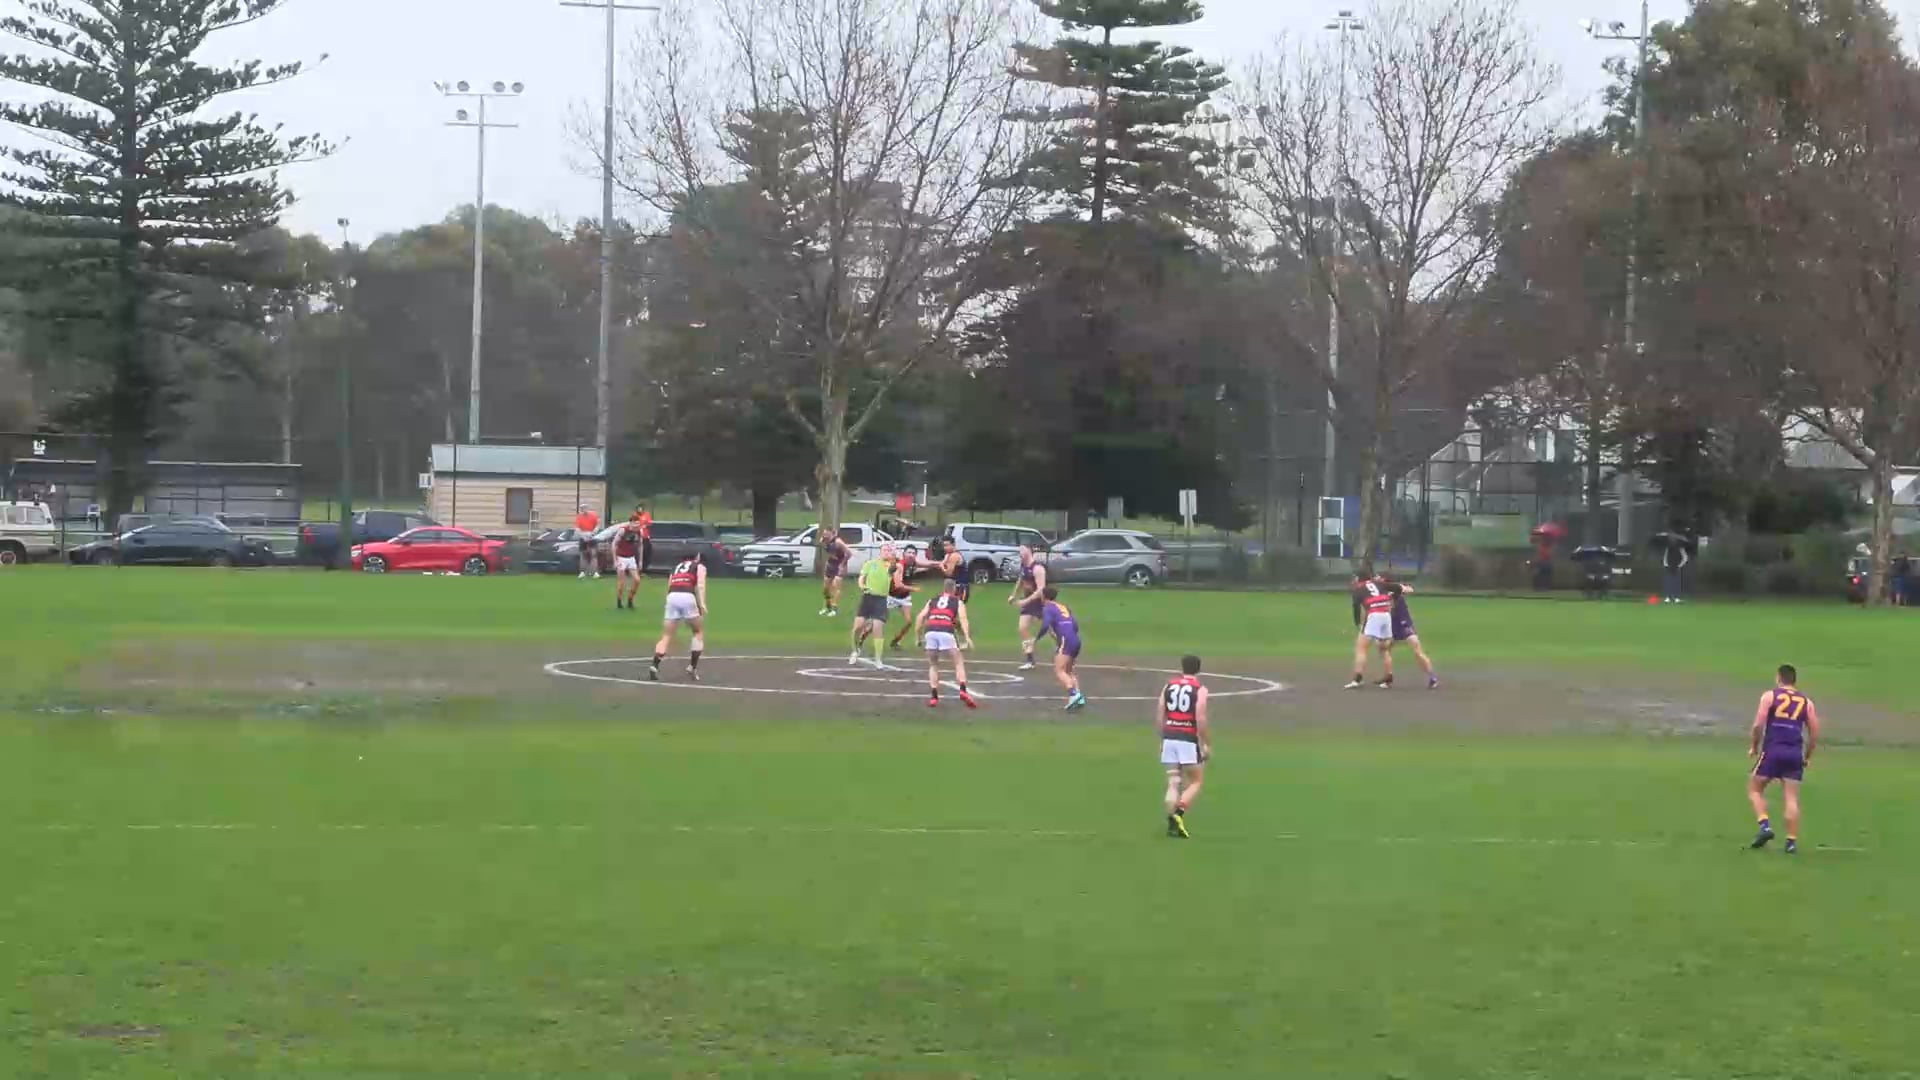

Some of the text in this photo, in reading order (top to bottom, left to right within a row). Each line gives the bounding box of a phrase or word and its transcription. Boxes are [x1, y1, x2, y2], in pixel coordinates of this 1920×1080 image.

[1365, 583, 1380, 596] 9
[937, 596, 949, 609] 8
[1167, 684, 1193, 713] 36
[1774, 693, 1806, 721] 27
